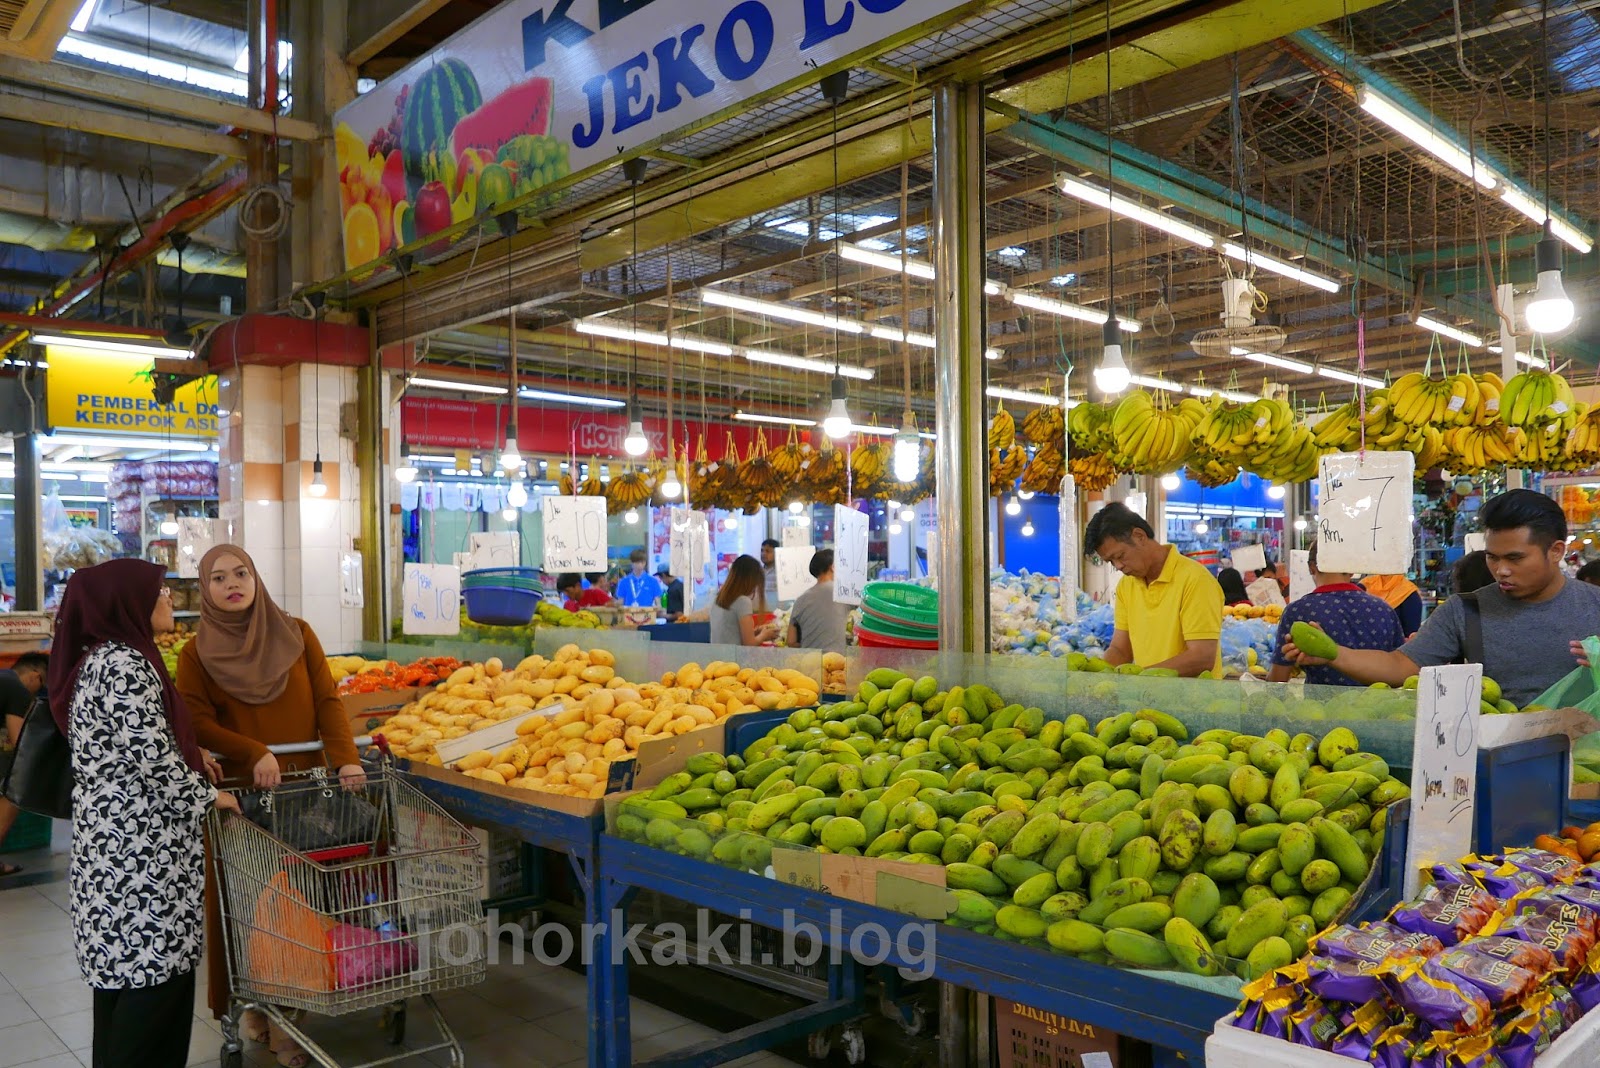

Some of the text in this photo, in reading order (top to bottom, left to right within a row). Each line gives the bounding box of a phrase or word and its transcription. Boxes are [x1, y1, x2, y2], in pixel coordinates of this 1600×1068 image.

[571, 0, 775, 149] JEKO
[76, 410, 176, 428] KEROPOK
[574, 510, 601, 551] 10
[1358, 475, 1395, 552] 7
[433, 586, 457, 621] 10
[1455, 674, 1475, 758] 8
[1045, 1026, 1059, 1036] 59
